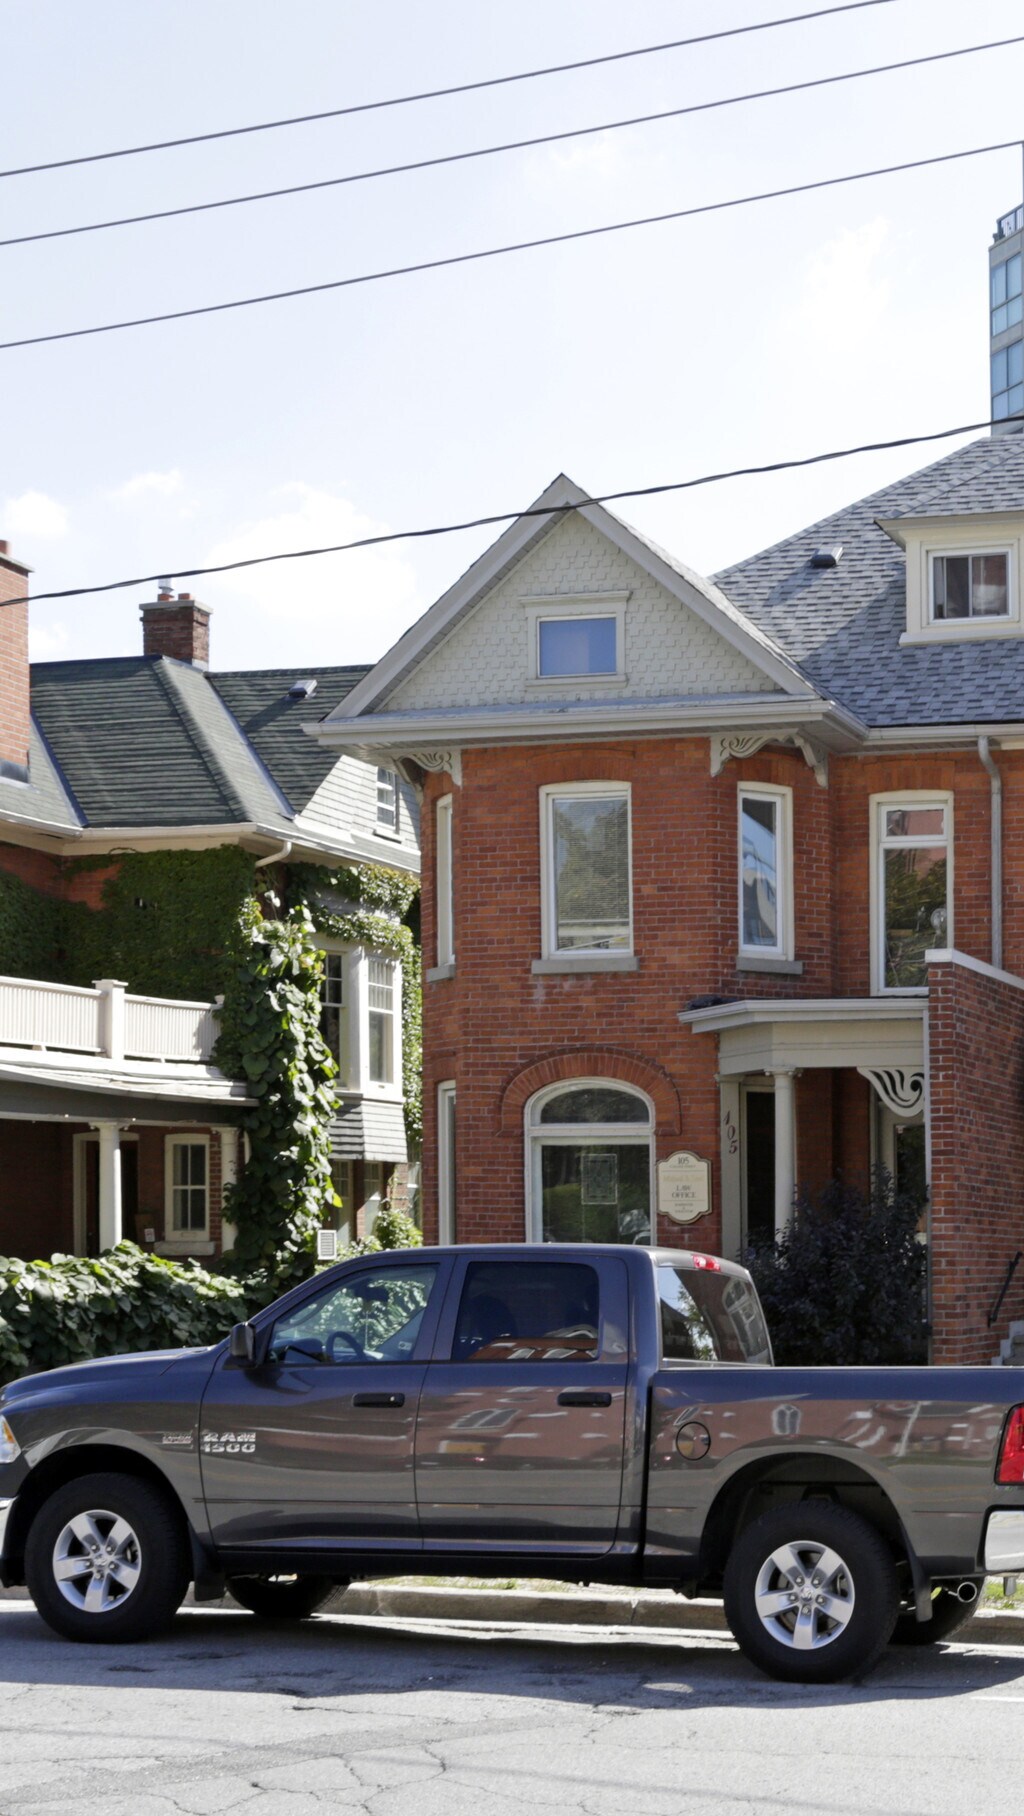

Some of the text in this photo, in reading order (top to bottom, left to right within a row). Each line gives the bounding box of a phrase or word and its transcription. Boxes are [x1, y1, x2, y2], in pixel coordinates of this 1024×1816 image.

[723, 1111, 738, 1154] 105
[678, 1156, 689, 1165] 105
[203, 1431, 256, 1442] RAM
[203, 1443, 256, 1453] 1500
